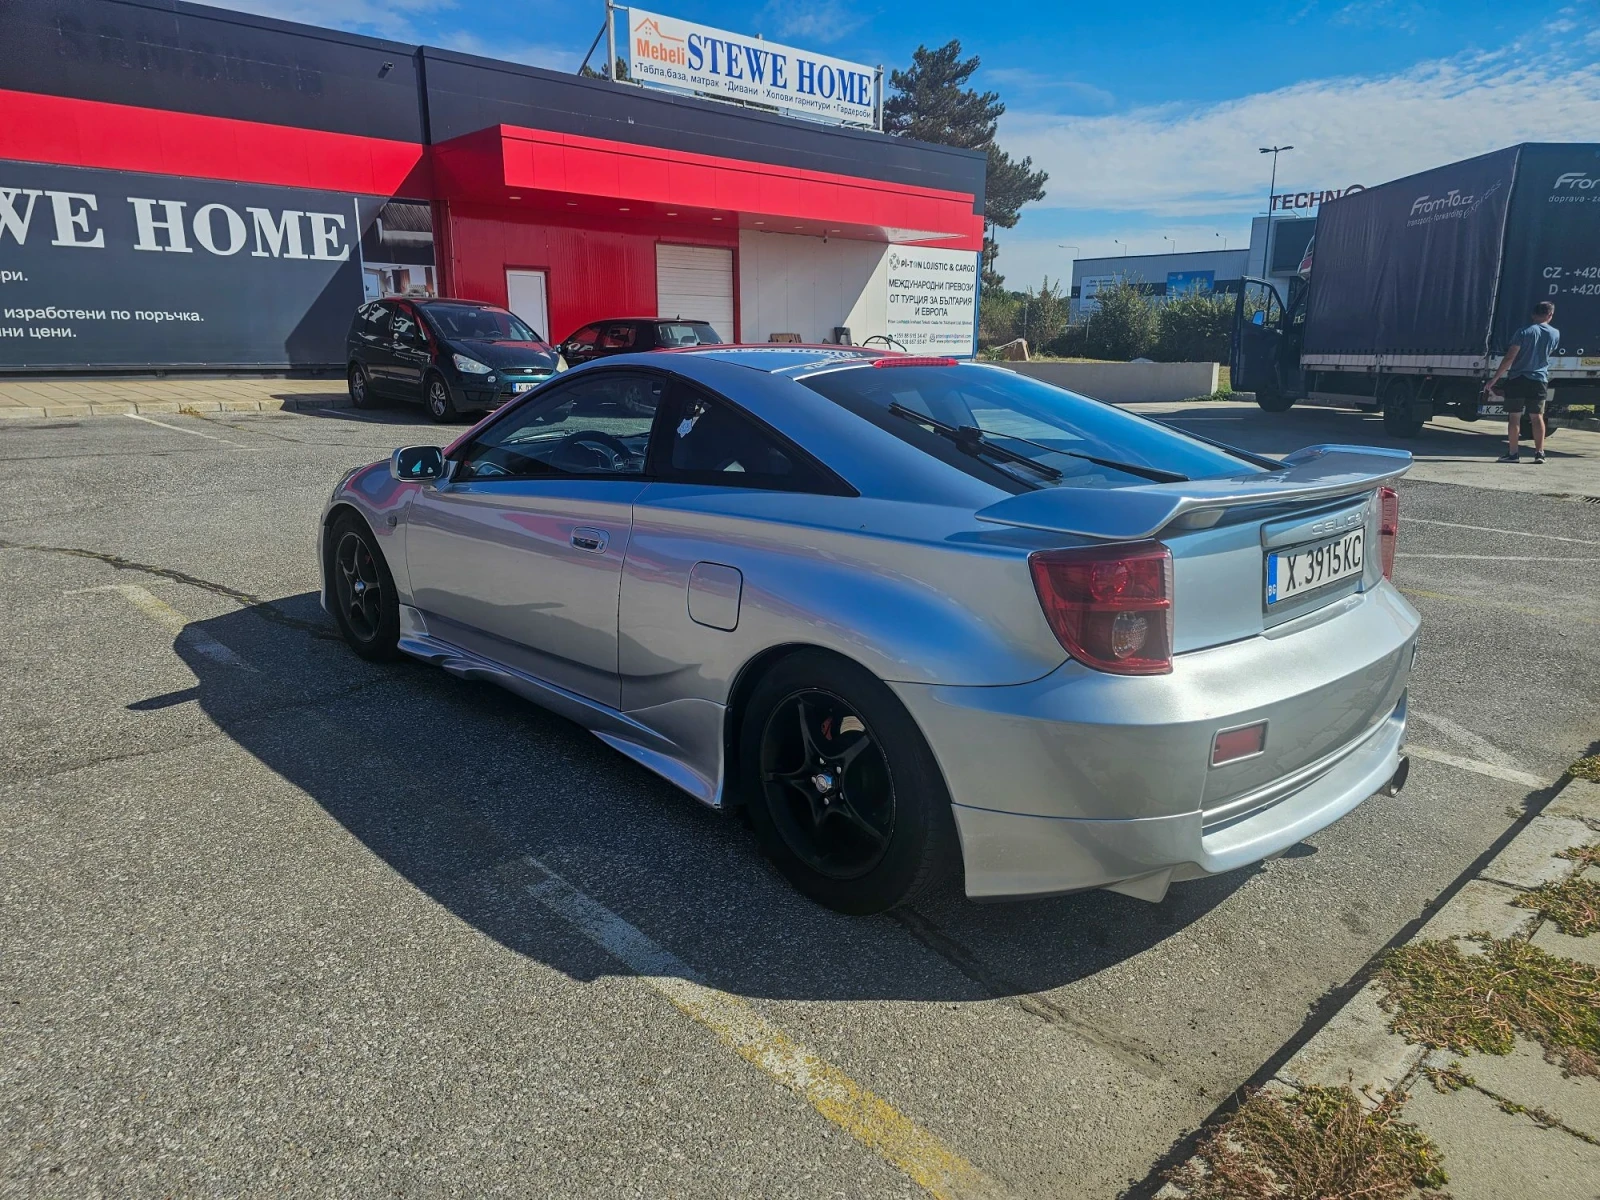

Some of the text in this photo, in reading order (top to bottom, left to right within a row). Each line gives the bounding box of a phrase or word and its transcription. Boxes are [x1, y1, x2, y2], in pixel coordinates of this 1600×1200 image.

[636, 33, 871, 107] Mebeli STEWE HOME
[691, 75, 720, 87] матрак
[795, 96, 831, 111] гарнитури
[1548, 195, 1585, 204] doprava
[127, 197, 350, 262] HOME
[955, 263, 975, 273] CARGO
[1543, 266, 1562, 278] CZ
[0, 270, 29, 284] ри.
[888, 279, 974, 292] МЕЖДУНАРОДНИ ПРЕВОЗИ
[1548, 284, 1558, 295] D
[889, 294, 972, 306] ОТ ТУРЦИЯ ЗА БЪЛГАРИЯ
[4, 306, 205, 324] изработени по поръчка.
[914, 307, 948, 317] И ЕВРОПА
[29, 327, 77, 340] цени.
[1312, 511, 1362, 535] CELICA
[1268, 584, 1277, 596] BG
